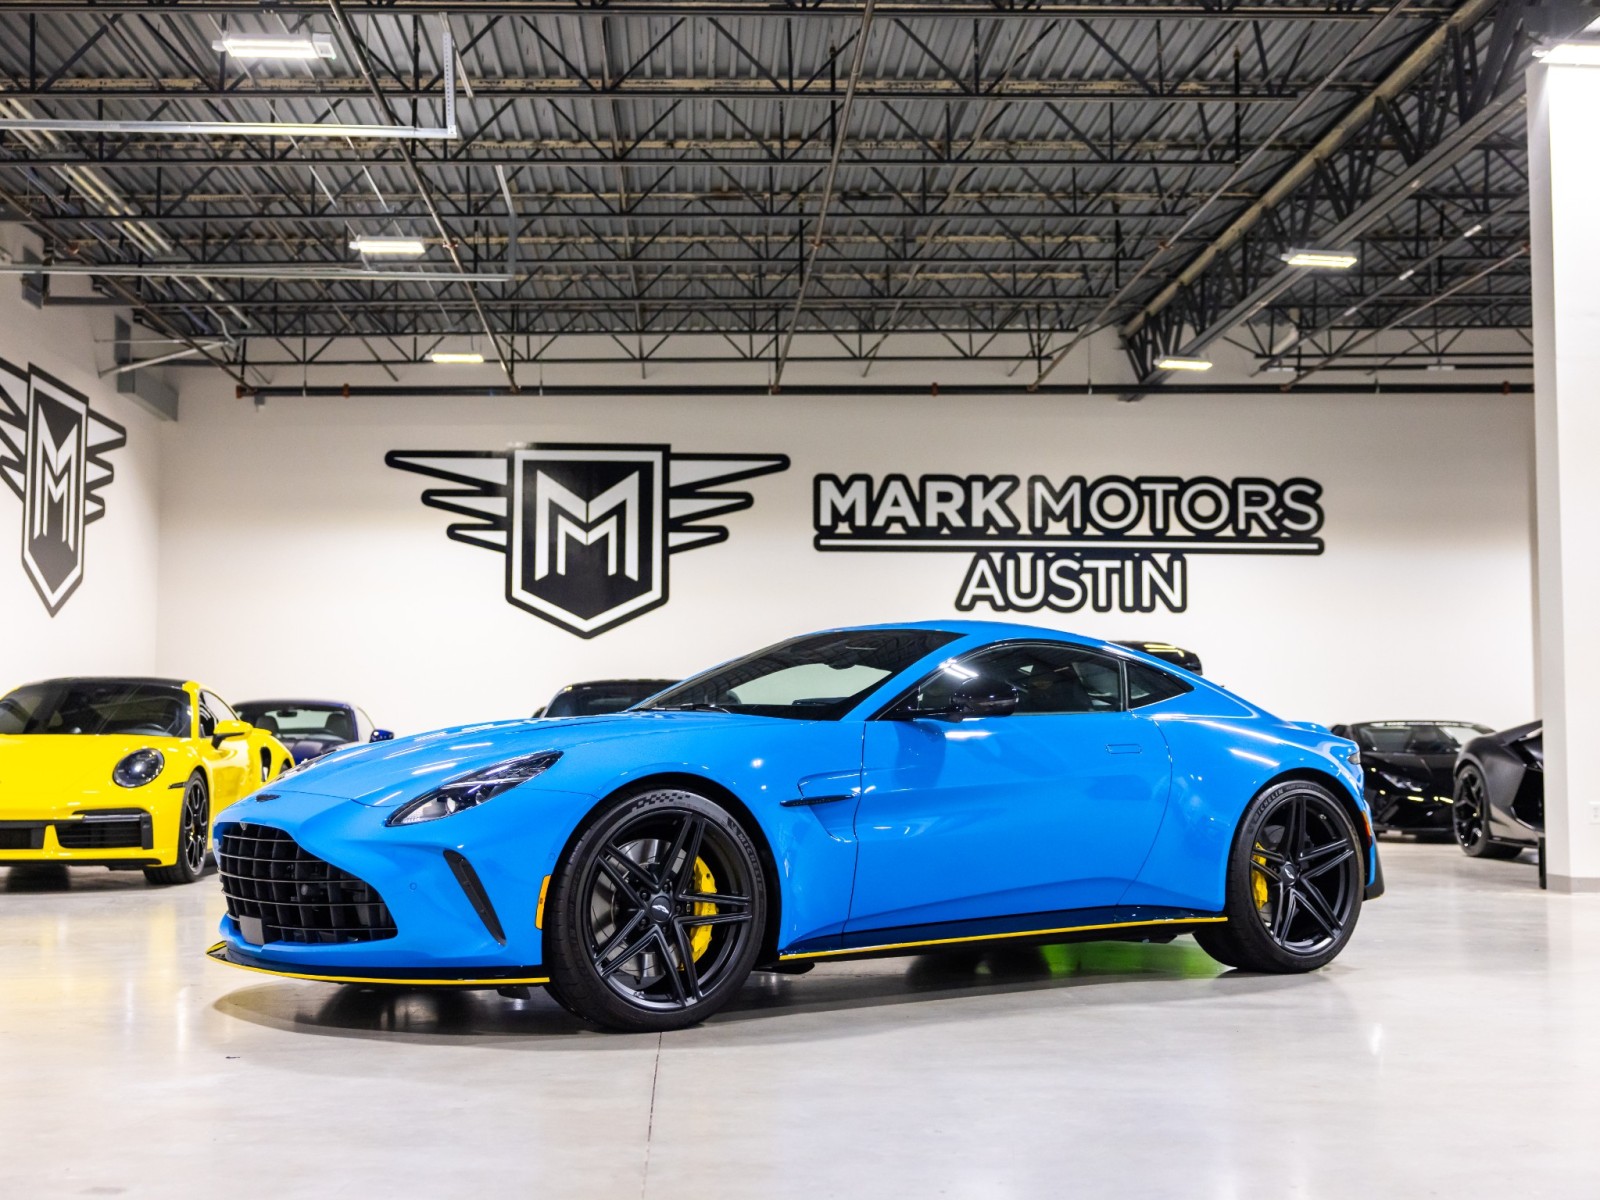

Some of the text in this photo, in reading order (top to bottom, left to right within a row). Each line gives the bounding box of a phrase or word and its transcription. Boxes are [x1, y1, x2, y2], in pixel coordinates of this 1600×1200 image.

[816, 477, 1321, 534] MARK MOTORS
[959, 555, 1184, 609] AUSTIN
[1254, 788, 1284, 820] MICHELIN
[737, 832, 763, 892] MICHELIN
